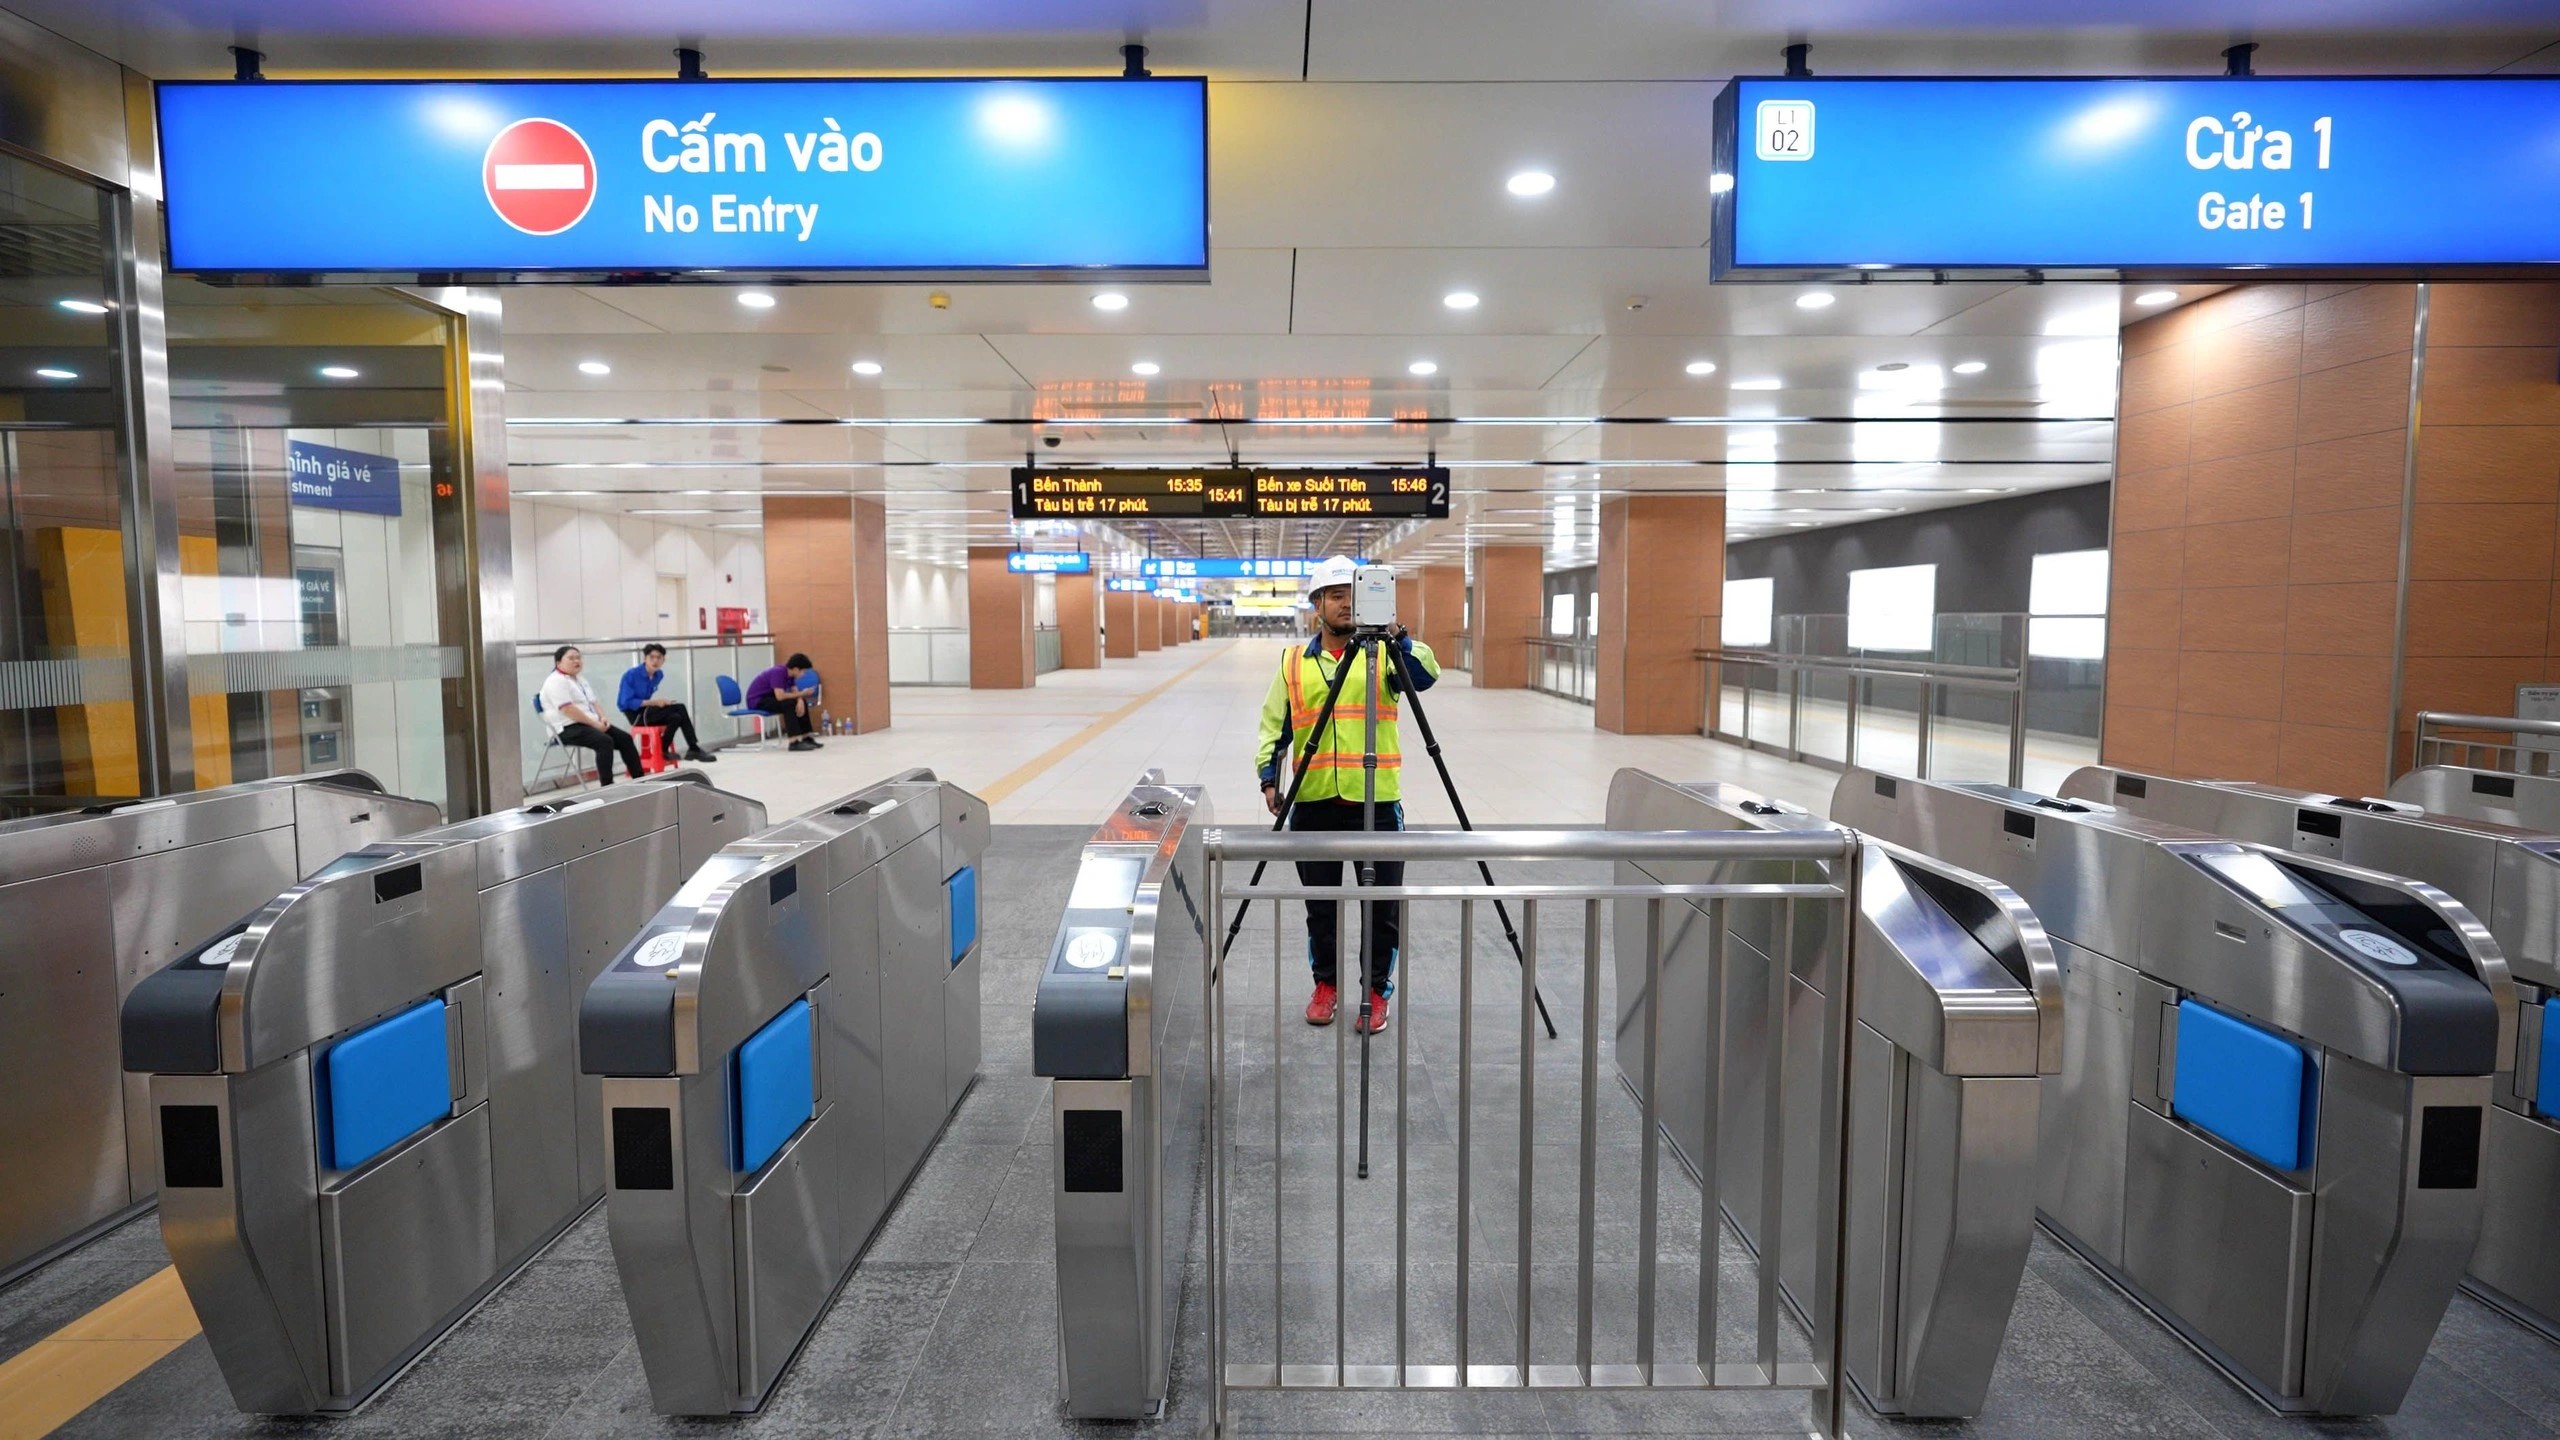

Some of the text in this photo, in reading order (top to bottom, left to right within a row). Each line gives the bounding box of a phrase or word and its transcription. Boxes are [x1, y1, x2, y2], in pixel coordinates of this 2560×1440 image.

[642, 113, 883, 173] Cấm vào
[1772, 129, 1799, 152] 02
[2186, 111, 2332, 170] Cửa 1
[644, 194, 819, 241] No Entry
[2198, 191, 2313, 230] Gate 1
[326, 460, 351, 482] giá
[353, 464, 372, 483] vé
[1018, 482, 1027, 505] 1
[1033, 476, 1203, 492] Bến Thành 15:35
[1208, 488, 1243, 502] 15:41
[1257, 476, 1427, 492] Bến xe Suối Tiên 15:46
[1431, 482, 1445, 505] 2
[1034, 498, 1060, 512] Tàu
[1062, 498, 1074, 514] bị
[1077, 496, 1094, 512] trễ
[1099, 498, 1116, 512] 17
[1258, 498, 1283, 512] Tàu
[1285, 498, 1297, 514] bị
[1301, 496, 1318, 512] trễ
[1322, 498, 1340, 512] 17
